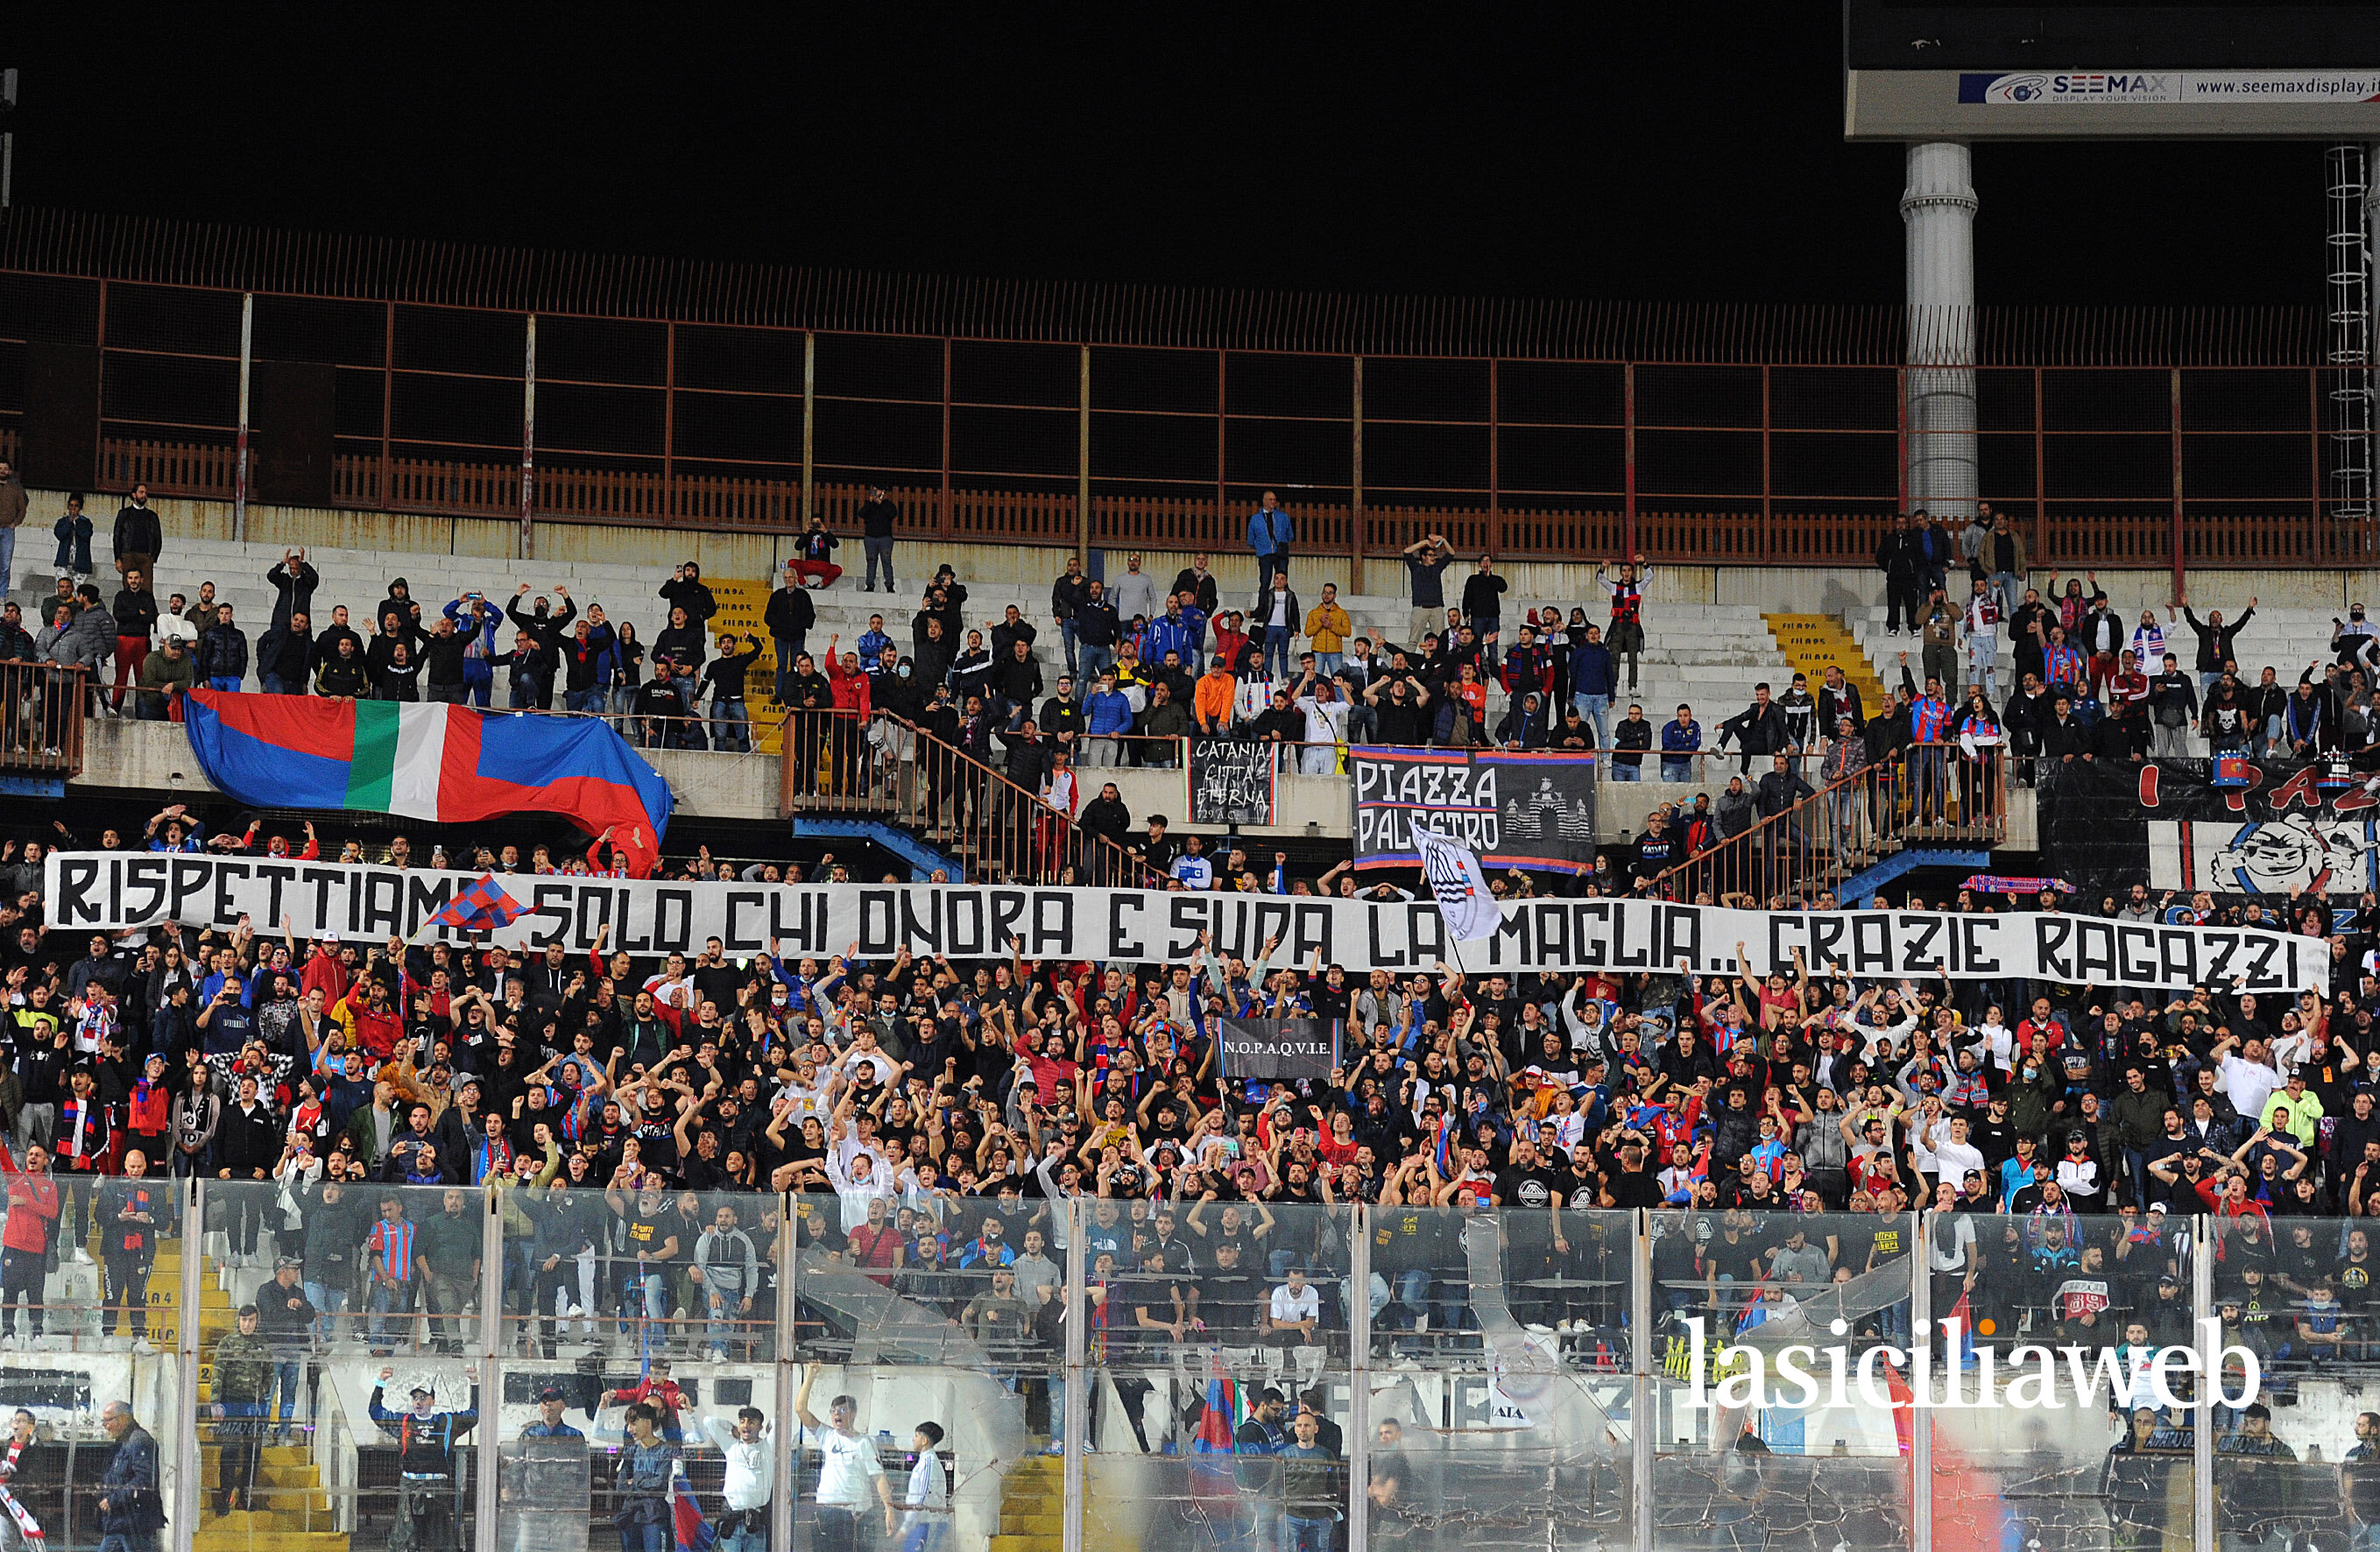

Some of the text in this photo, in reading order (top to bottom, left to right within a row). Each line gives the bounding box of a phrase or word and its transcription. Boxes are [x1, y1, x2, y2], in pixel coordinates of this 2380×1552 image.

[2052, 75, 2167, 94] SEEMAX
[1197, 740, 1266, 761] CATANIA
[1357, 761, 1497, 808] PIAZZA
[1197, 788, 1266, 808] ETERNA
[57, 857, 492, 942] RISPETTIAM
[532, 884, 692, 952] SOLO
[725, 890, 830, 955] CHI
[859, 890, 1074, 956] ONORA
[1109, 893, 1143, 958] E
[1168, 897, 1332, 964] SUDA
[1368, 903, 1445, 968] LA
[1769, 914, 2000, 973] GRAZIE
[2035, 917, 2299, 988] RAGAZZI
[223, 1019, 245, 1028] PUMA
[1224, 1041, 1331, 1056] N.O.P.A.Q.V.I.E.
[164, 1292, 172, 1303] 4
